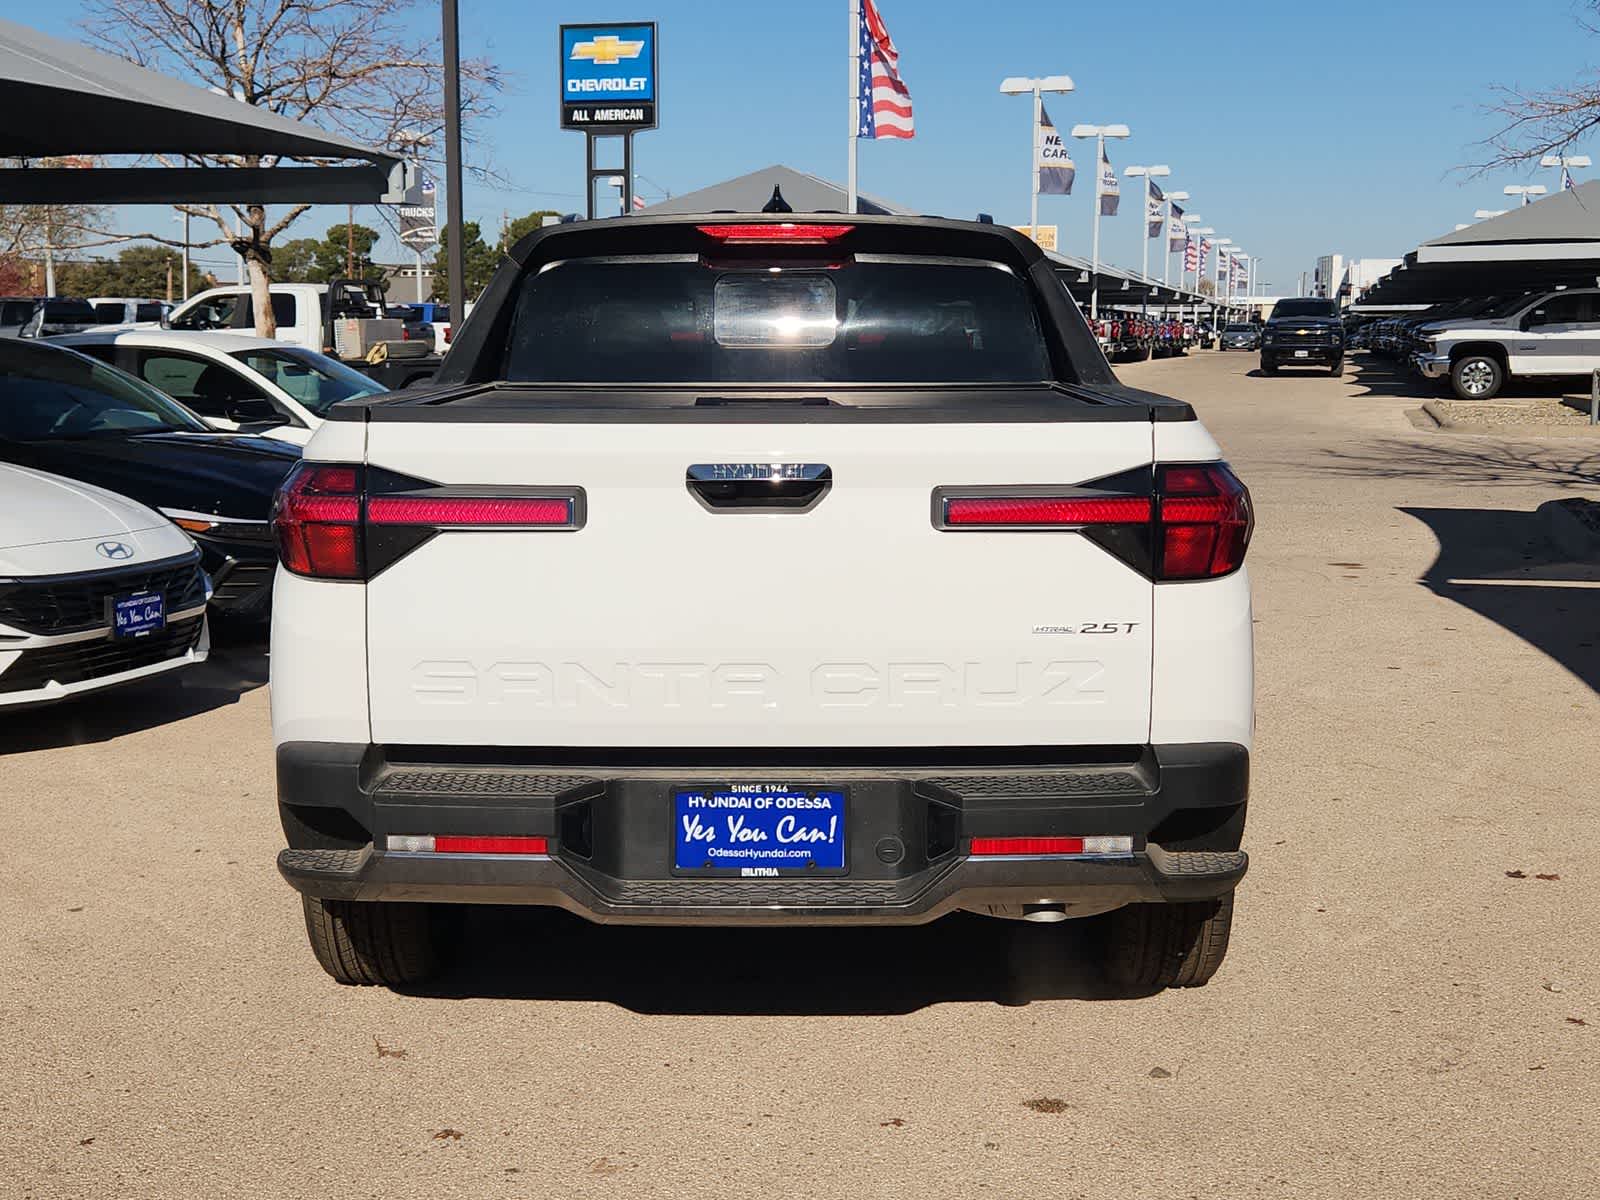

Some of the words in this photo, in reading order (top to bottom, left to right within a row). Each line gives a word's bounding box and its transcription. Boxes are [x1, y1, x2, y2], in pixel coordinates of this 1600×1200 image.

[567, 78, 647, 92] CHEVROLET
[572, 110, 590, 121] ALL
[594, 109, 644, 121] AMERICAN
[1045, 135, 1062, 146] NE
[1042, 148, 1071, 159] CAR
[400, 207, 434, 217] TRUCKS
[116, 611, 128, 627] Yes
[411, 659, 779, 708] SANTA
[809, 660, 1105, 708] CRUZ
[731, 785, 762, 793] SINCE
[765, 785, 789, 793] 1946
[688, 796, 751, 809] HYUNDAI
[754, 797, 773, 809] OF
[775, 797, 832, 809] ODESSA
[682, 814, 716, 842] Yes
[727, 815, 768, 843] You
[776, 815, 838, 843] Can!
[707, 847, 811, 860] OdessaHyundai.com
[751, 867, 780, 877] LITHIA
